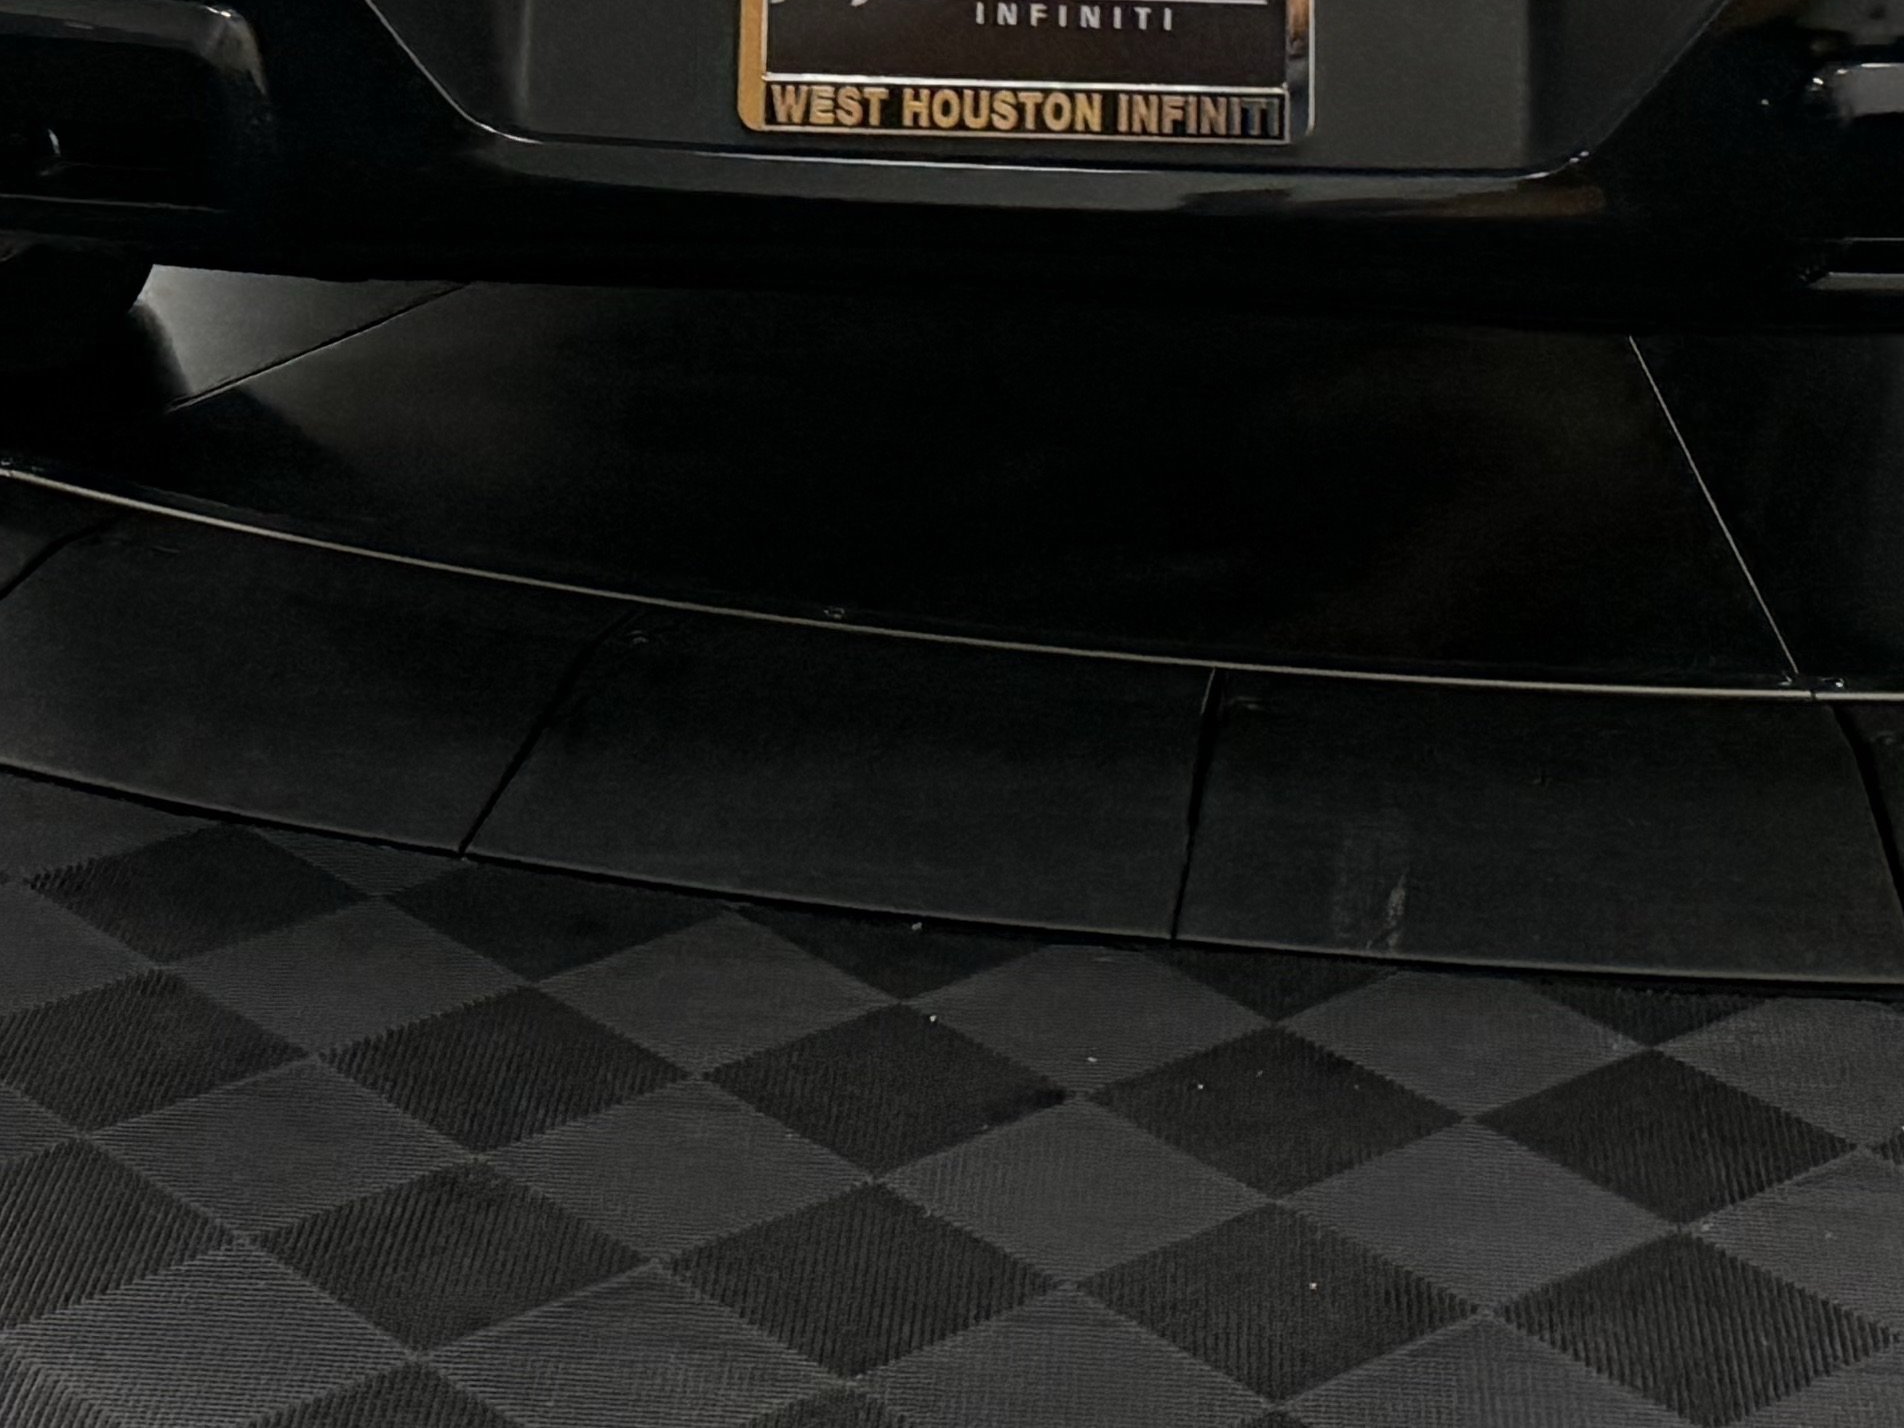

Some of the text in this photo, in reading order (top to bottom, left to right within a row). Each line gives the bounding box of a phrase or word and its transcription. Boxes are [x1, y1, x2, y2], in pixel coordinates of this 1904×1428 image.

[976, 2, 1173, 31] INFINITI
[772, 86, 1281, 137] WEST HOUSTON INFINITI
